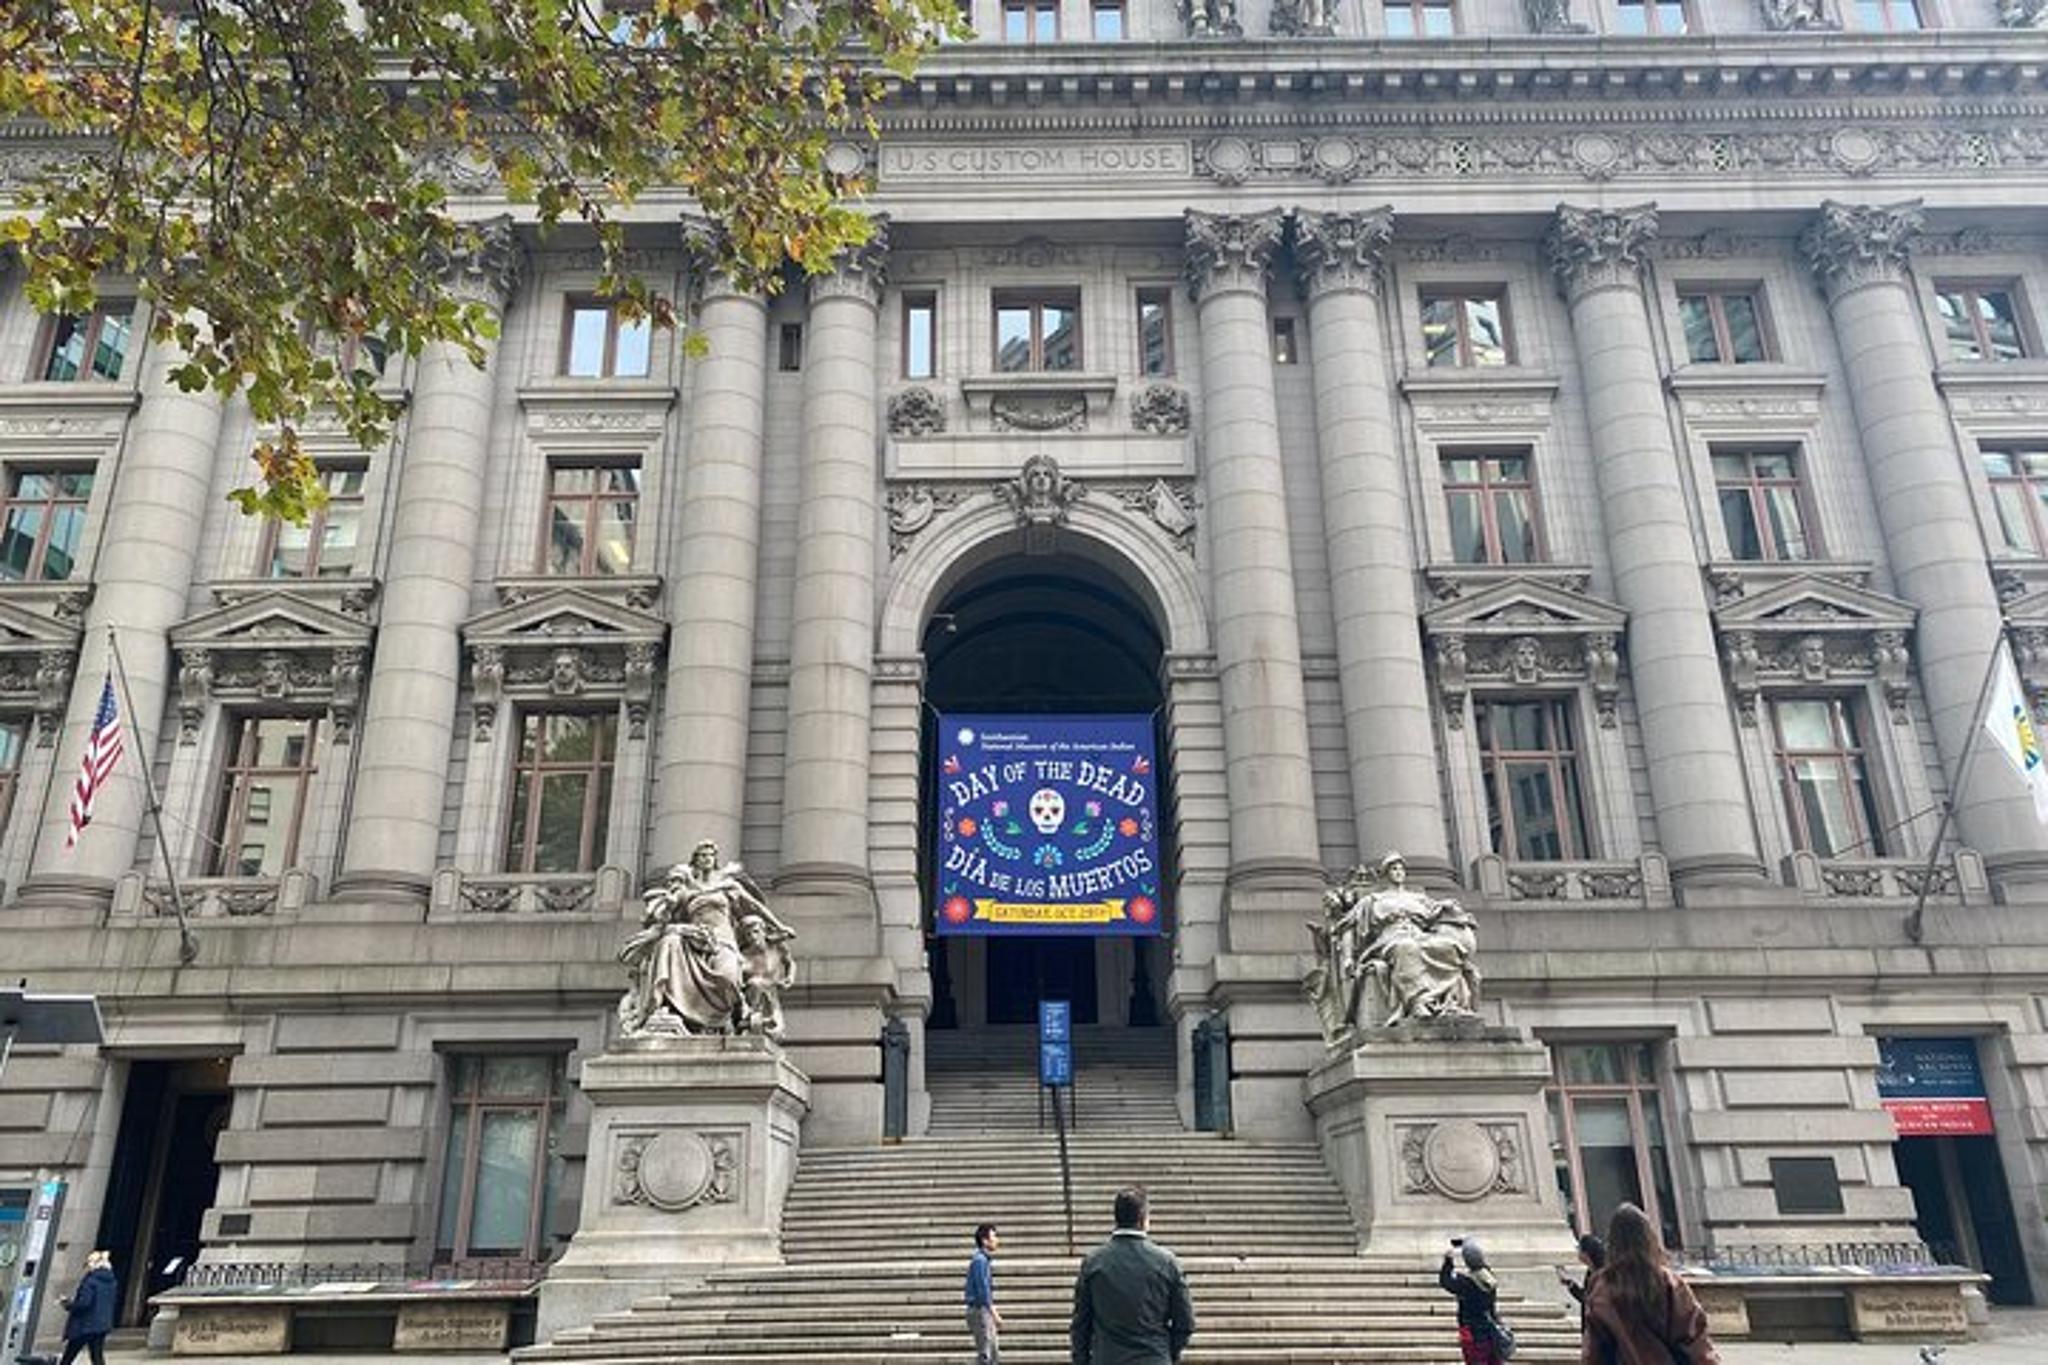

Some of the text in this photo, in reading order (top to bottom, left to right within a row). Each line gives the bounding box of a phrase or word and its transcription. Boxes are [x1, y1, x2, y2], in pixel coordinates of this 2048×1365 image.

[950, 148, 1065, 171] CUSTOM
[1080, 147, 1177, 169] HOUSE
[949, 760, 1146, 807] DAY OF THE DEAD
[943, 844, 1153, 899] DÍA DE LOS MUERTOS
